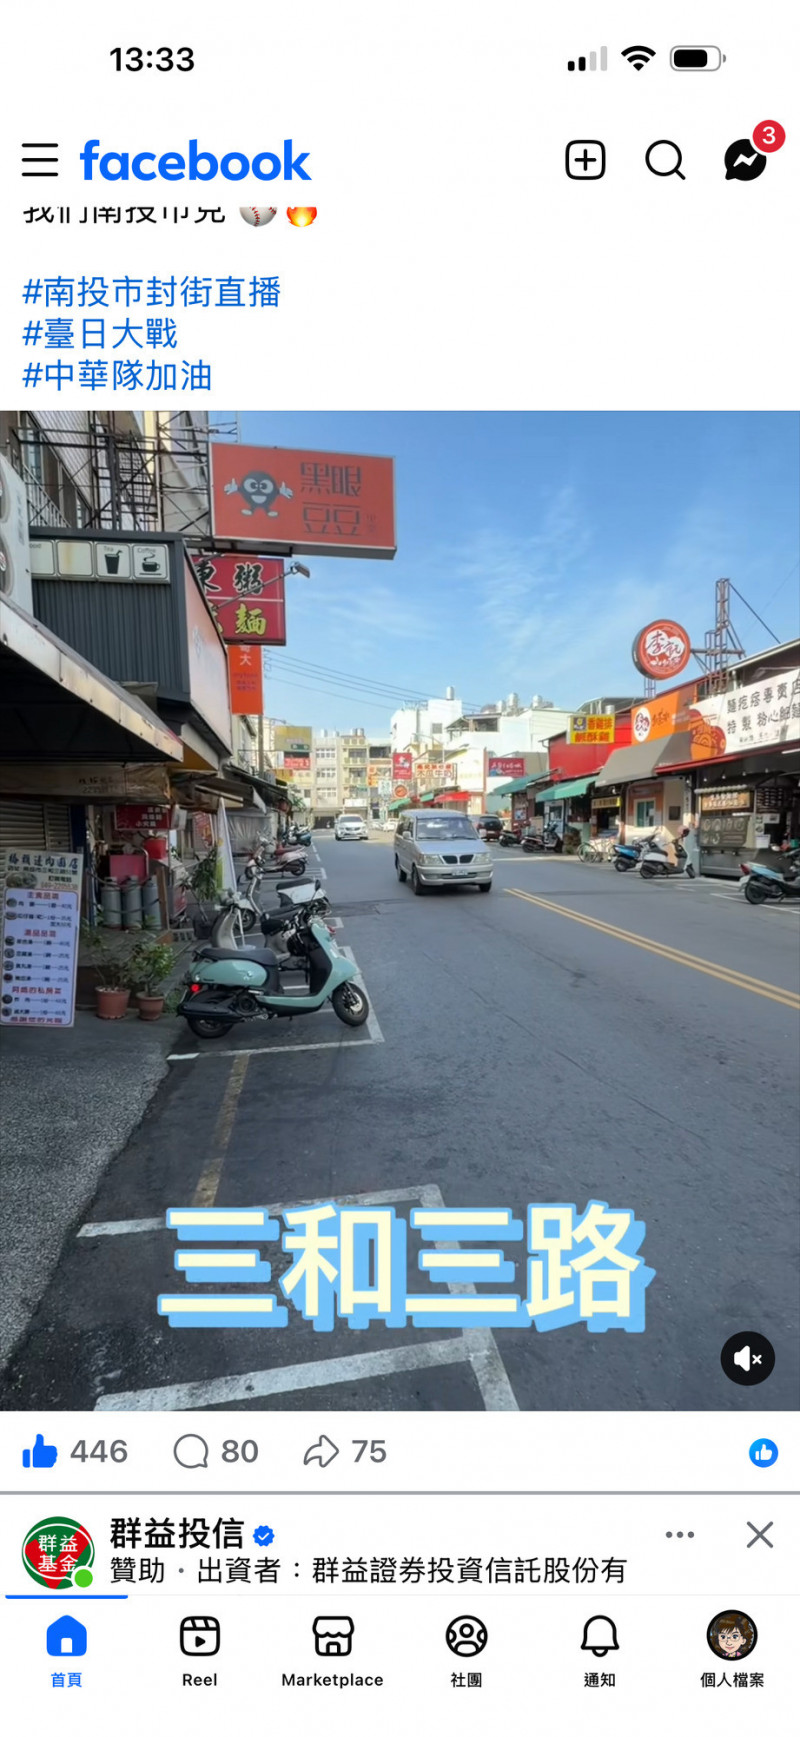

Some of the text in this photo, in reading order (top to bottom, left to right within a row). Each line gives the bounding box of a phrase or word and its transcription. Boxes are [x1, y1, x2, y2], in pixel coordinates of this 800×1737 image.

[110, 47, 194, 72] 13:33
[762, 126, 776, 145] 3
[80, 139, 312, 181] facebook
[22, 275, 281, 308] #南投市封街直播
[22, 317, 178, 349] #臺日大戰
[22, 359, 212, 391] #中華隊加油
[300, 461, 362, 497] 黑眼
[302, 501, 361, 536] 豆豆
[70, 1440, 128, 1463] 446
[222, 1440, 259, 1463] 80
[352, 1440, 387, 1463] 75
[38, 1534, 78, 1552] 群益
[110, 1517, 245, 1549] 群益投信
[38, 1554, 78, 1572] 基金
[111, 1557, 165, 1584] 贊助
[51, 1672, 82, 1688] 首頁
[183, 1673, 217, 1687] Reel
[282, 1673, 383, 1690] Marketplace
[451, 1672, 482, 1688] 社團
[584, 1672, 615, 1688] 通知
[700, 1672, 764, 1688] 個人檔案
